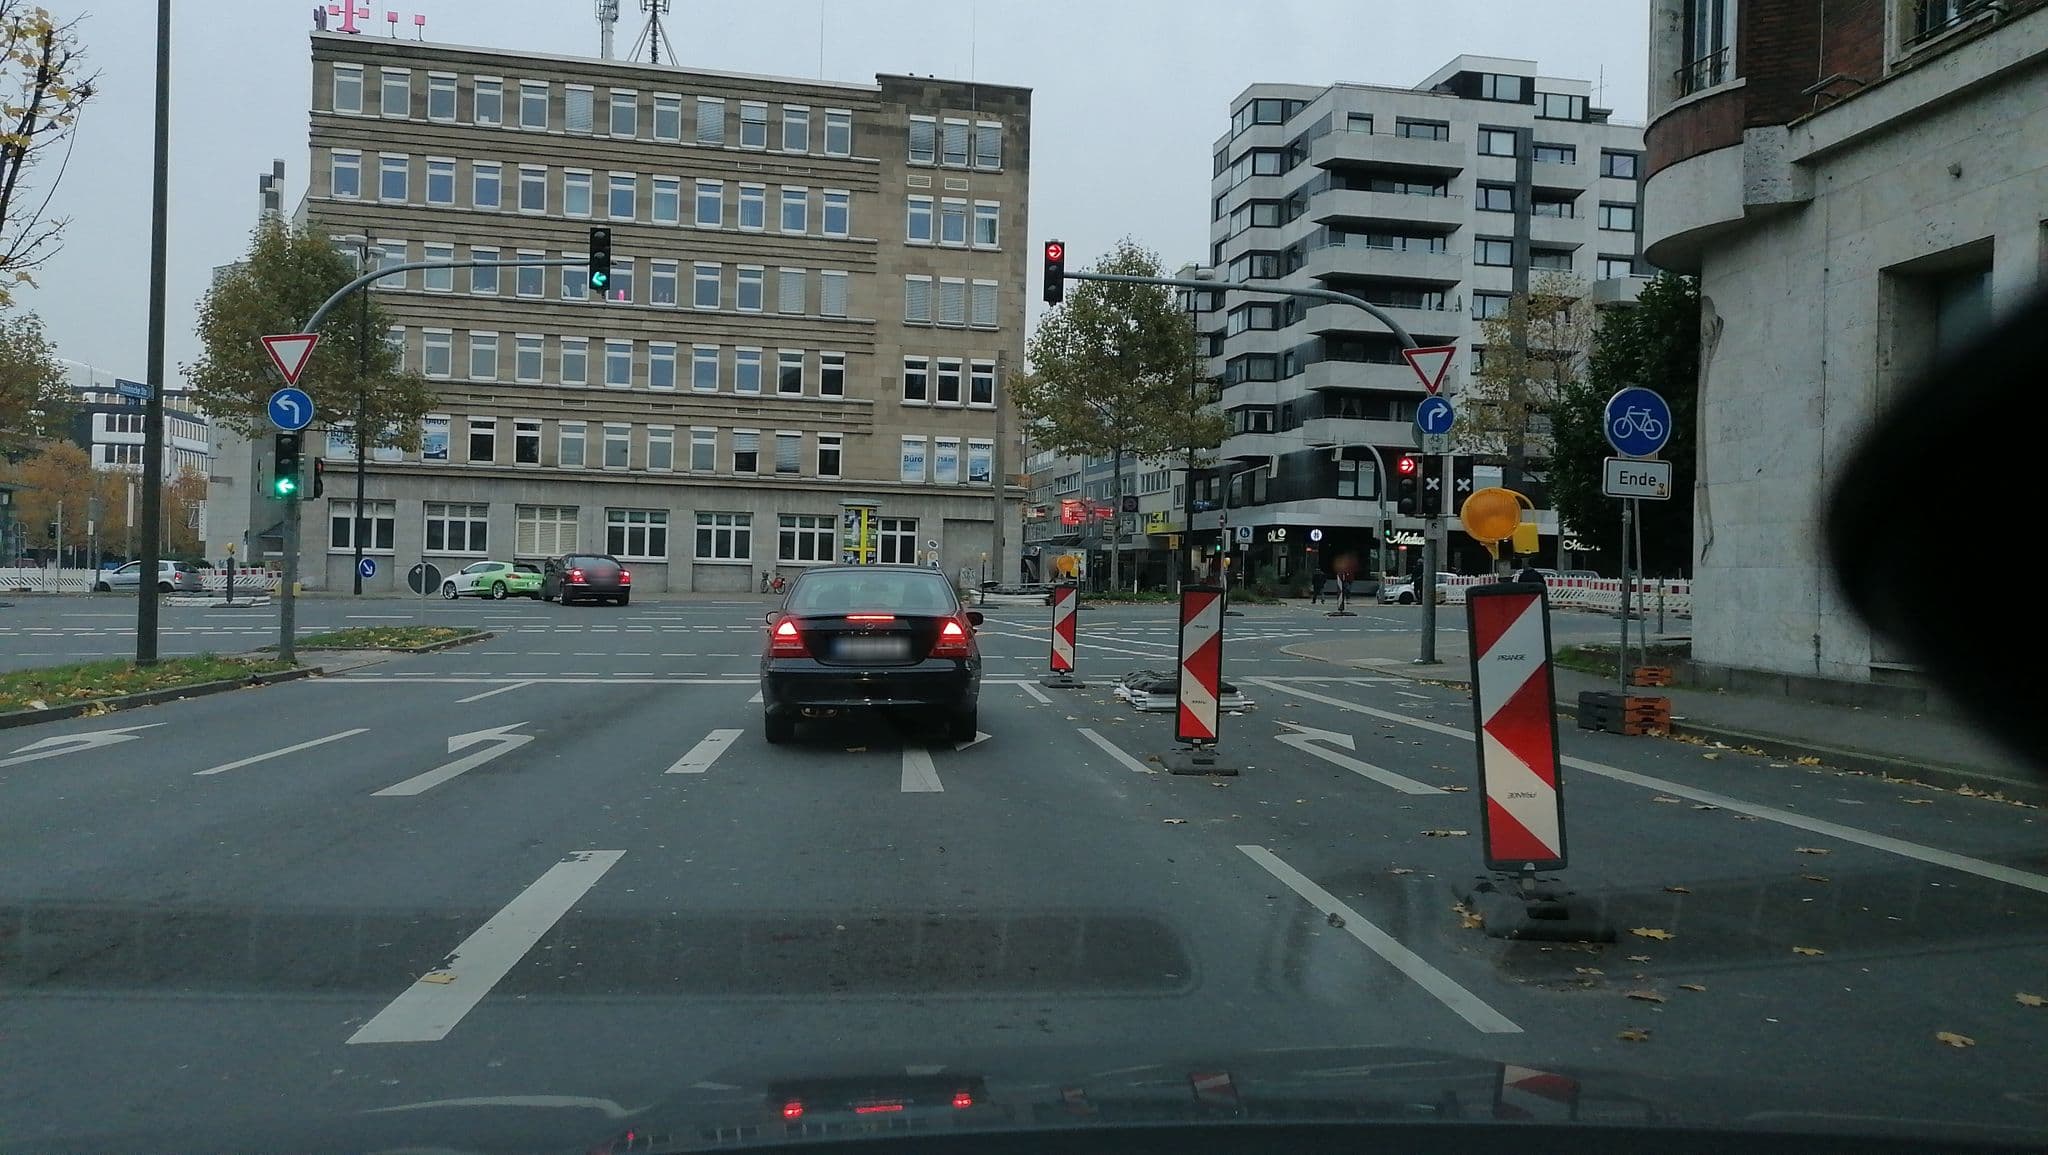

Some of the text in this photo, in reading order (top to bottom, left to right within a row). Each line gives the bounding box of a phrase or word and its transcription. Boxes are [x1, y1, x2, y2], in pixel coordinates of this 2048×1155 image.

[903, 454, 923, 463] Büro
[1619, 471, 1657, 487] Ende
[1496, 653, 1527, 661] PRANGE
